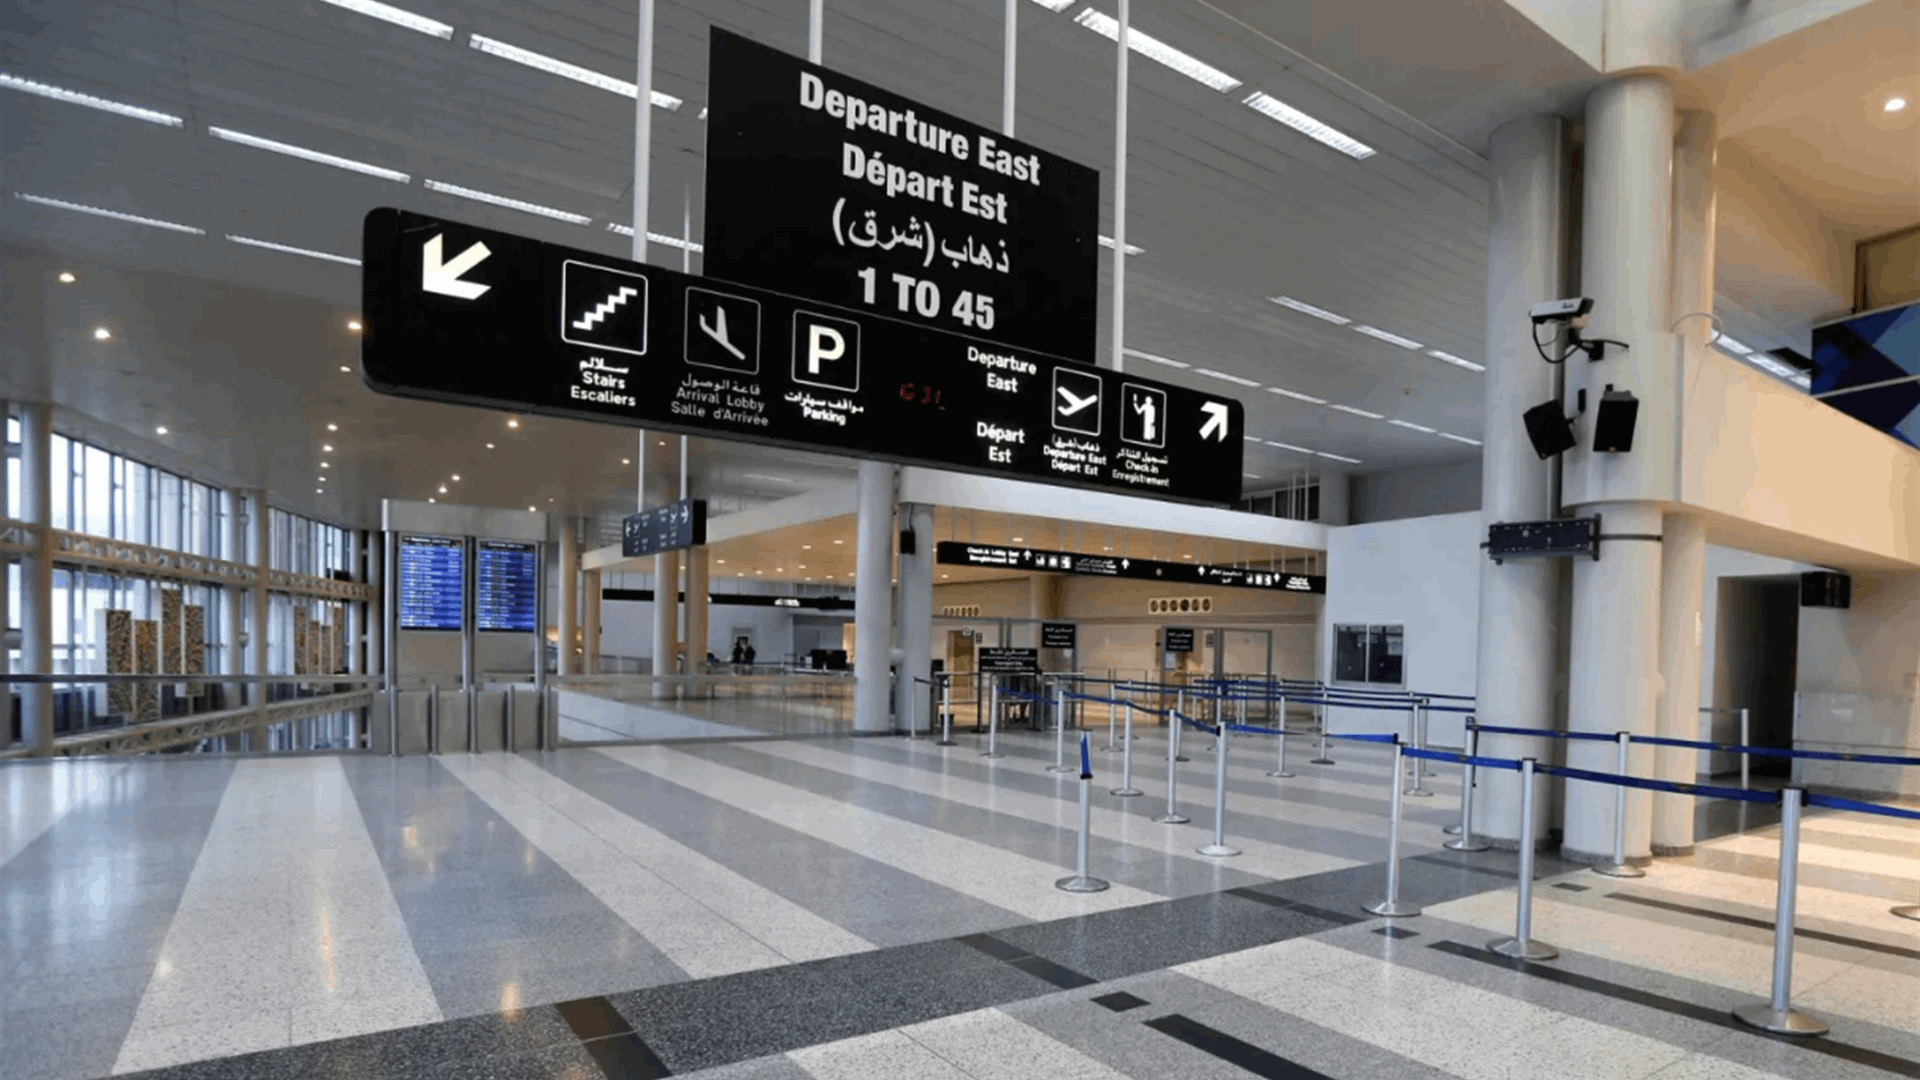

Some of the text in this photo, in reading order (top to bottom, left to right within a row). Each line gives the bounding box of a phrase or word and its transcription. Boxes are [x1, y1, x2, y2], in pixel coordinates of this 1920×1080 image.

[800, 71, 1040, 185] Departure East
[843, 142, 1007, 224] Départ Est
[832, 198, 1010, 273] ذهاب (شرق)
[857, 267, 995, 330] 1 TO 45
[808, 324, 845, 374] P
[967, 346, 1037, 376] Departure
[582, 370, 626, 389] Stairs
[681, 373, 760, 396] قاعة الوصول
[986, 372, 1018, 393] East
[571, 384, 636, 407] Escaliers
[676, 386, 765, 413] Arrival Lobby
[671, 401, 769, 426] Salle d'Arrivée
[803, 405, 846, 426] Parking
[976, 421, 1025, 444] Départ
[988, 446, 1012, 463] Est
[1043, 445, 1107, 466] Departure East
[1051, 458, 1099, 476] Départ Est
[1112, 469, 1170, 487] Enregistrement
